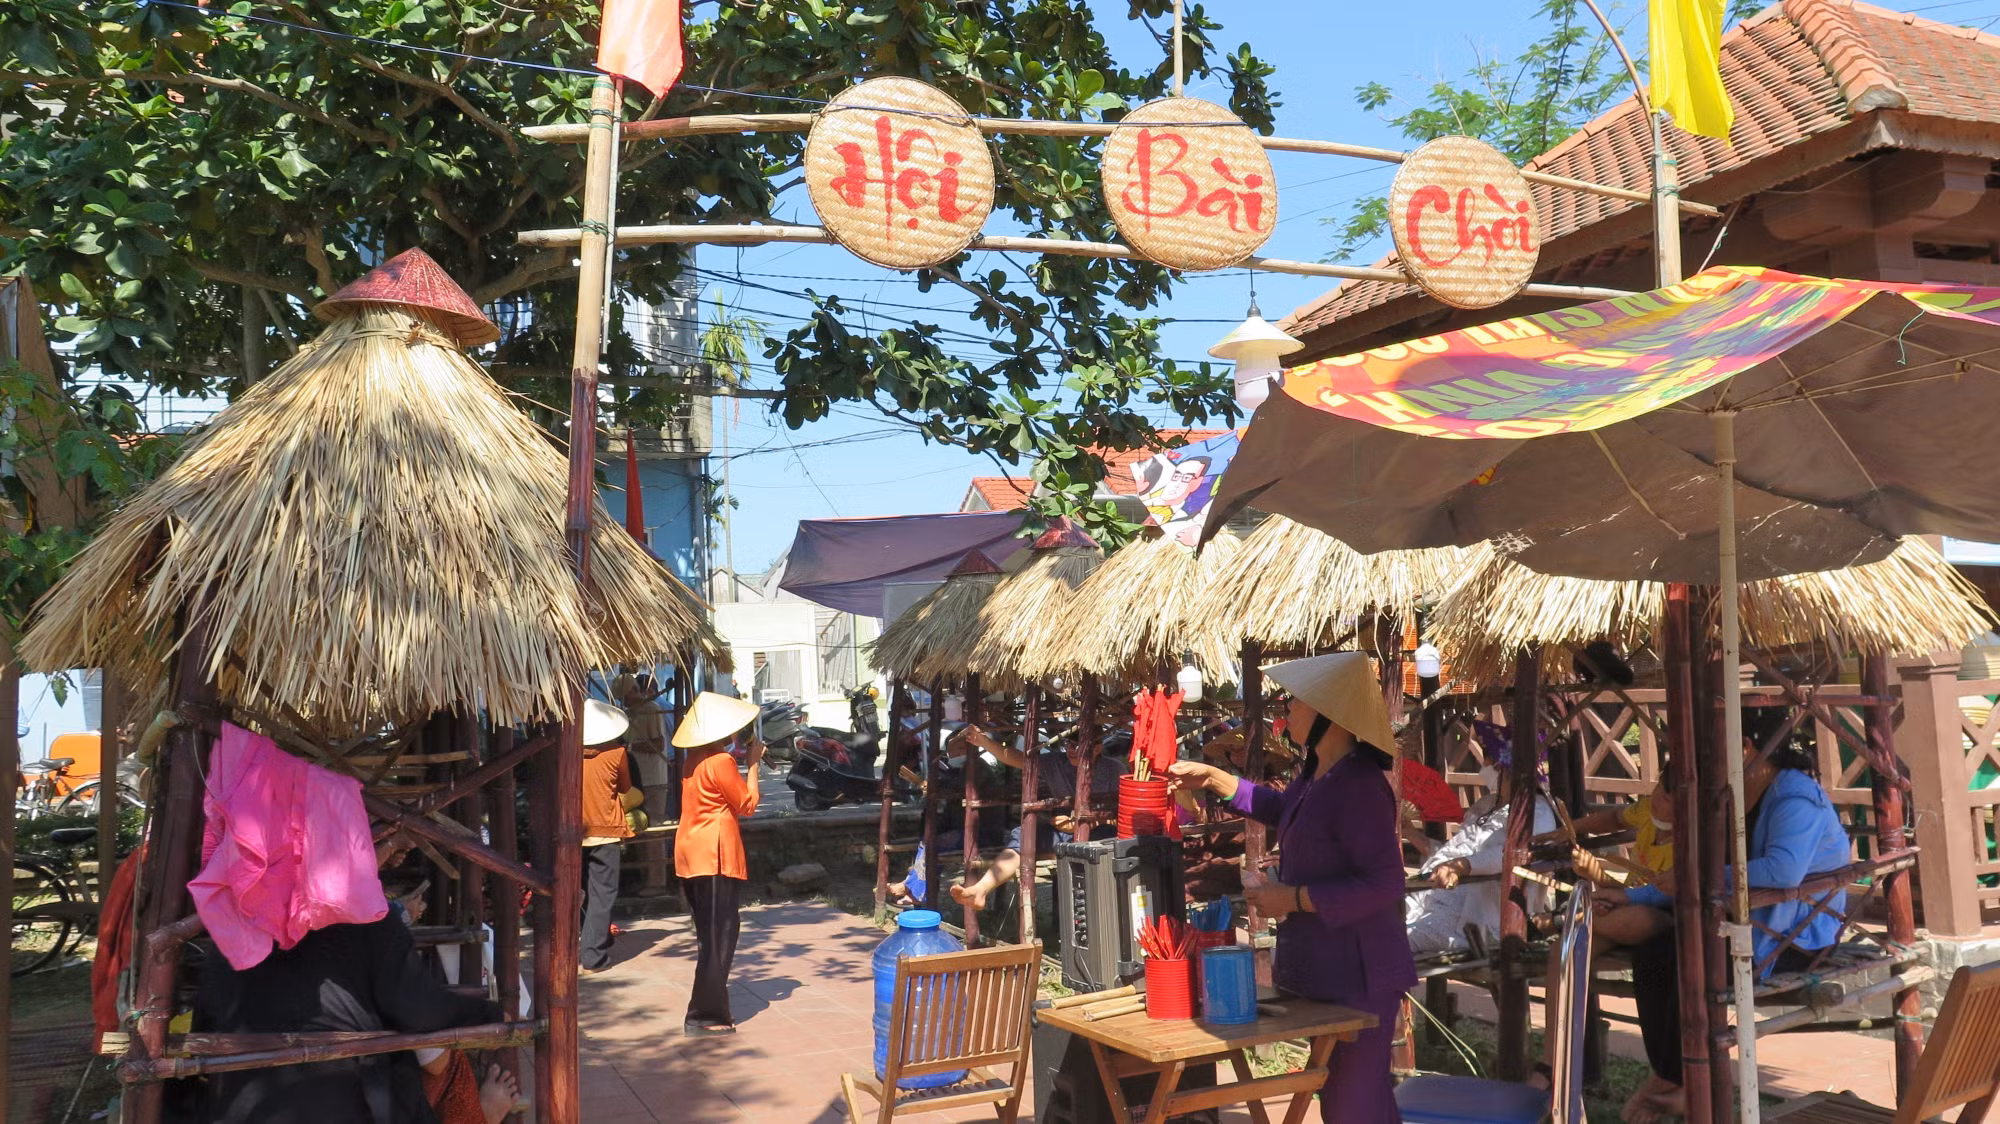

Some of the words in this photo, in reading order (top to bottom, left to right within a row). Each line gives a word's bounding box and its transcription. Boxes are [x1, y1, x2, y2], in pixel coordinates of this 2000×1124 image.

[829, 115, 982, 240] Hội
[1122, 127, 1268, 234] Bài
[1406, 183, 1537, 271] Chòi
